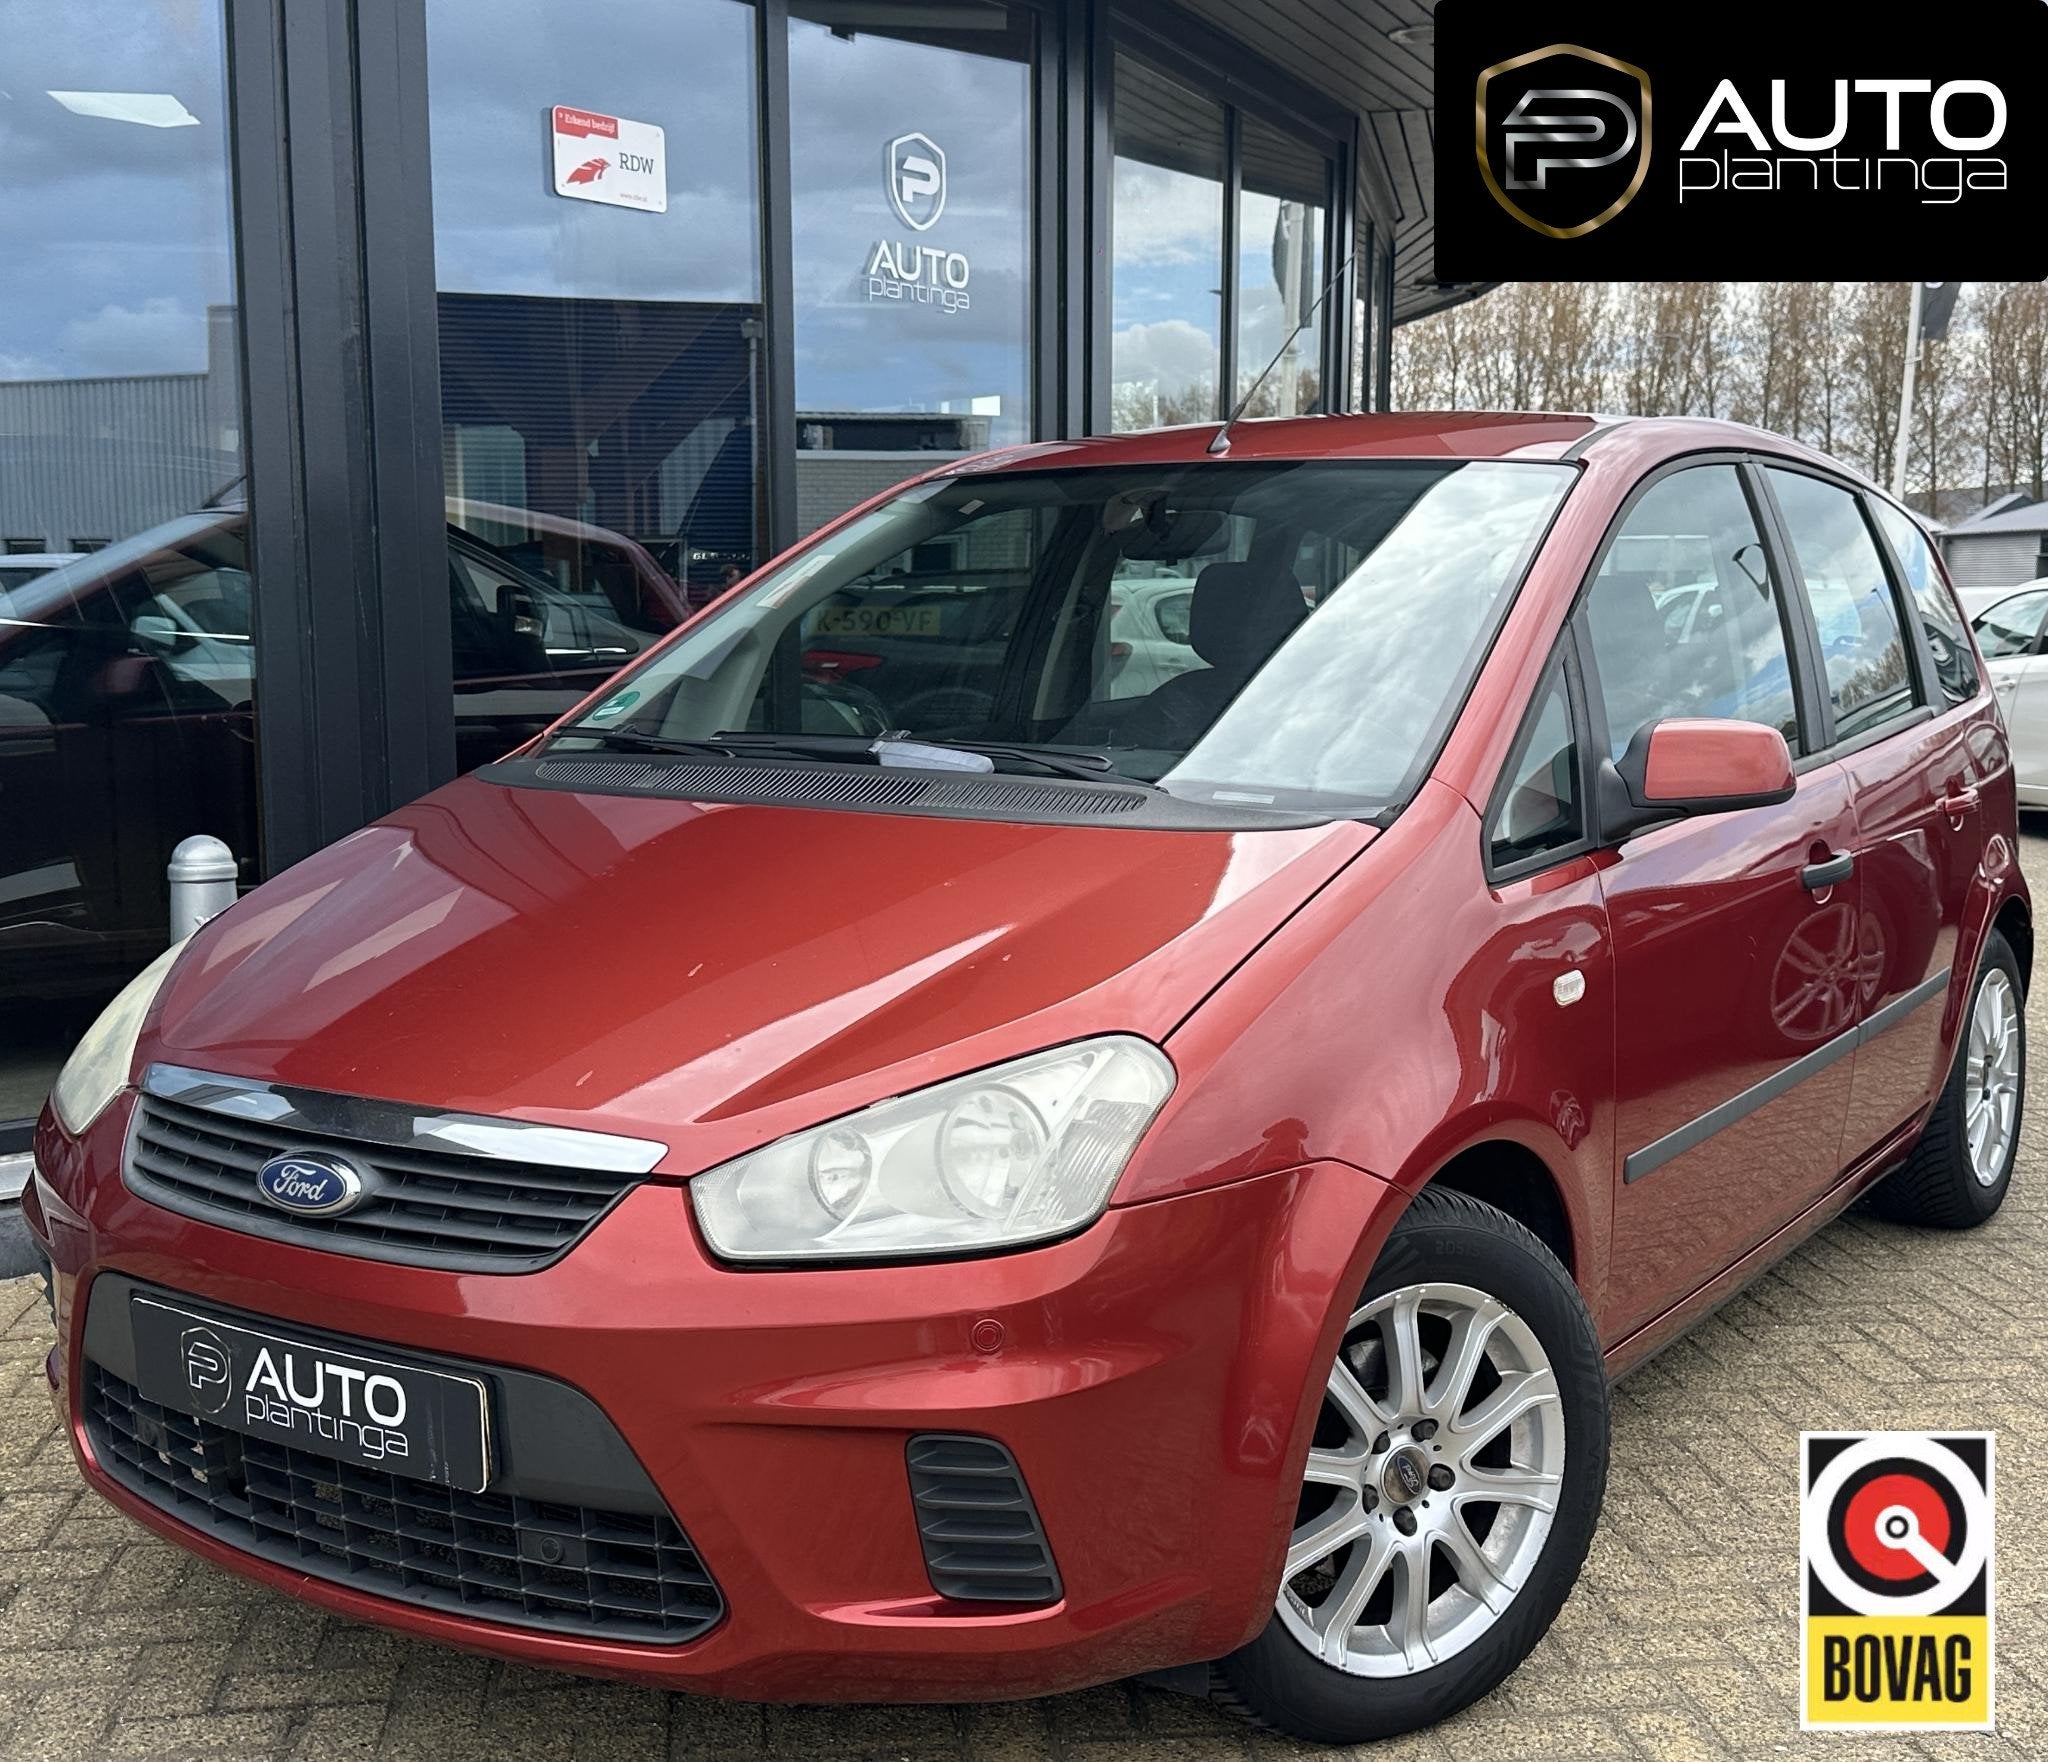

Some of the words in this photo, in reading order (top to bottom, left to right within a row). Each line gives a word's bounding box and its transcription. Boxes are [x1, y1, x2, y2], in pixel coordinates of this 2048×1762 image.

[618, 152, 655, 175] RDW
[869, 239, 970, 289] AUTO
[869, 276, 970, 314] plantinga
[273, 1164, 329, 1201] Ford
[245, 1347, 407, 1427] AUTO
[245, 1394, 409, 1460] plantinga
